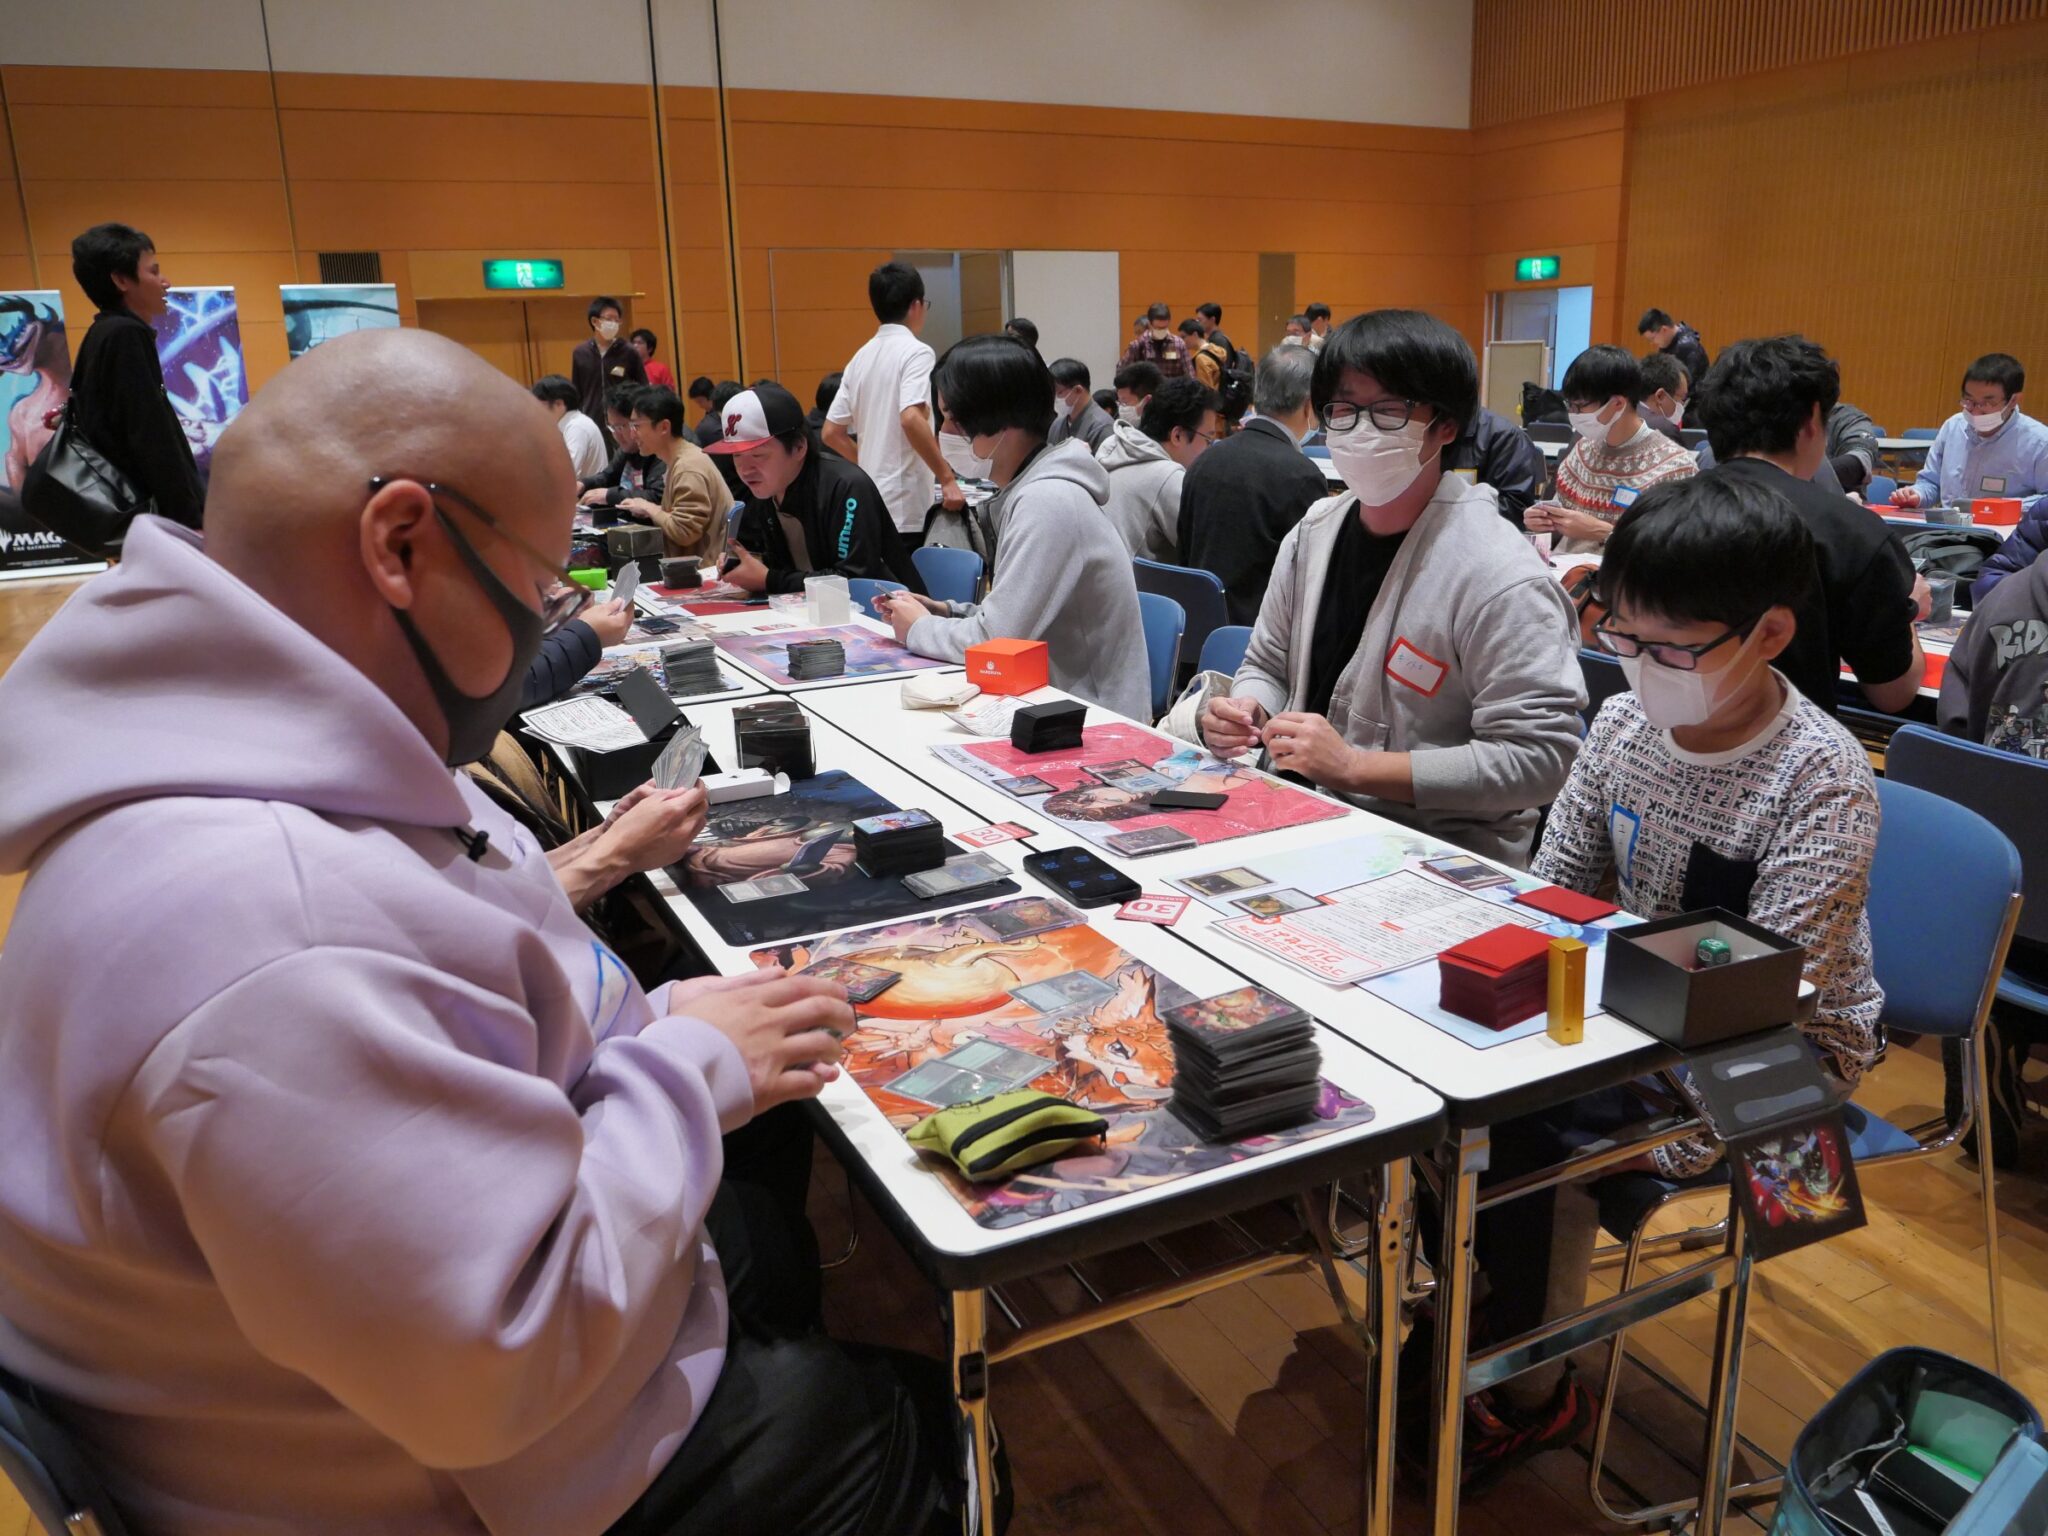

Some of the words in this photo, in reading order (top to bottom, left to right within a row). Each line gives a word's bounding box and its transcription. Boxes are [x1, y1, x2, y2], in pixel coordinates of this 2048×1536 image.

[838, 497, 857, 559] umbro
[12, 530, 66, 547] MAG
[1794, 771, 1824, 796] MUSIC
[1702, 788, 1717, 804] PE
[1644, 810, 1665, 827] K-12
[1681, 812, 1709, 830] MATH
[1813, 814, 1829, 831] PE
[1665, 820, 1704, 842] LIBRARY
[1709, 821, 1739, 838] WASK
[1792, 845, 1831, 859] MATH
[1811, 835, 1858, 852] STUDIES
[1832, 849, 1859, 862] WASK
[1793, 873, 1822, 888] WASK
[1131, 901, 1176, 915] 30
[1769, 885, 1793, 927] SCIENCE
[1790, 900, 1807, 917] PE
